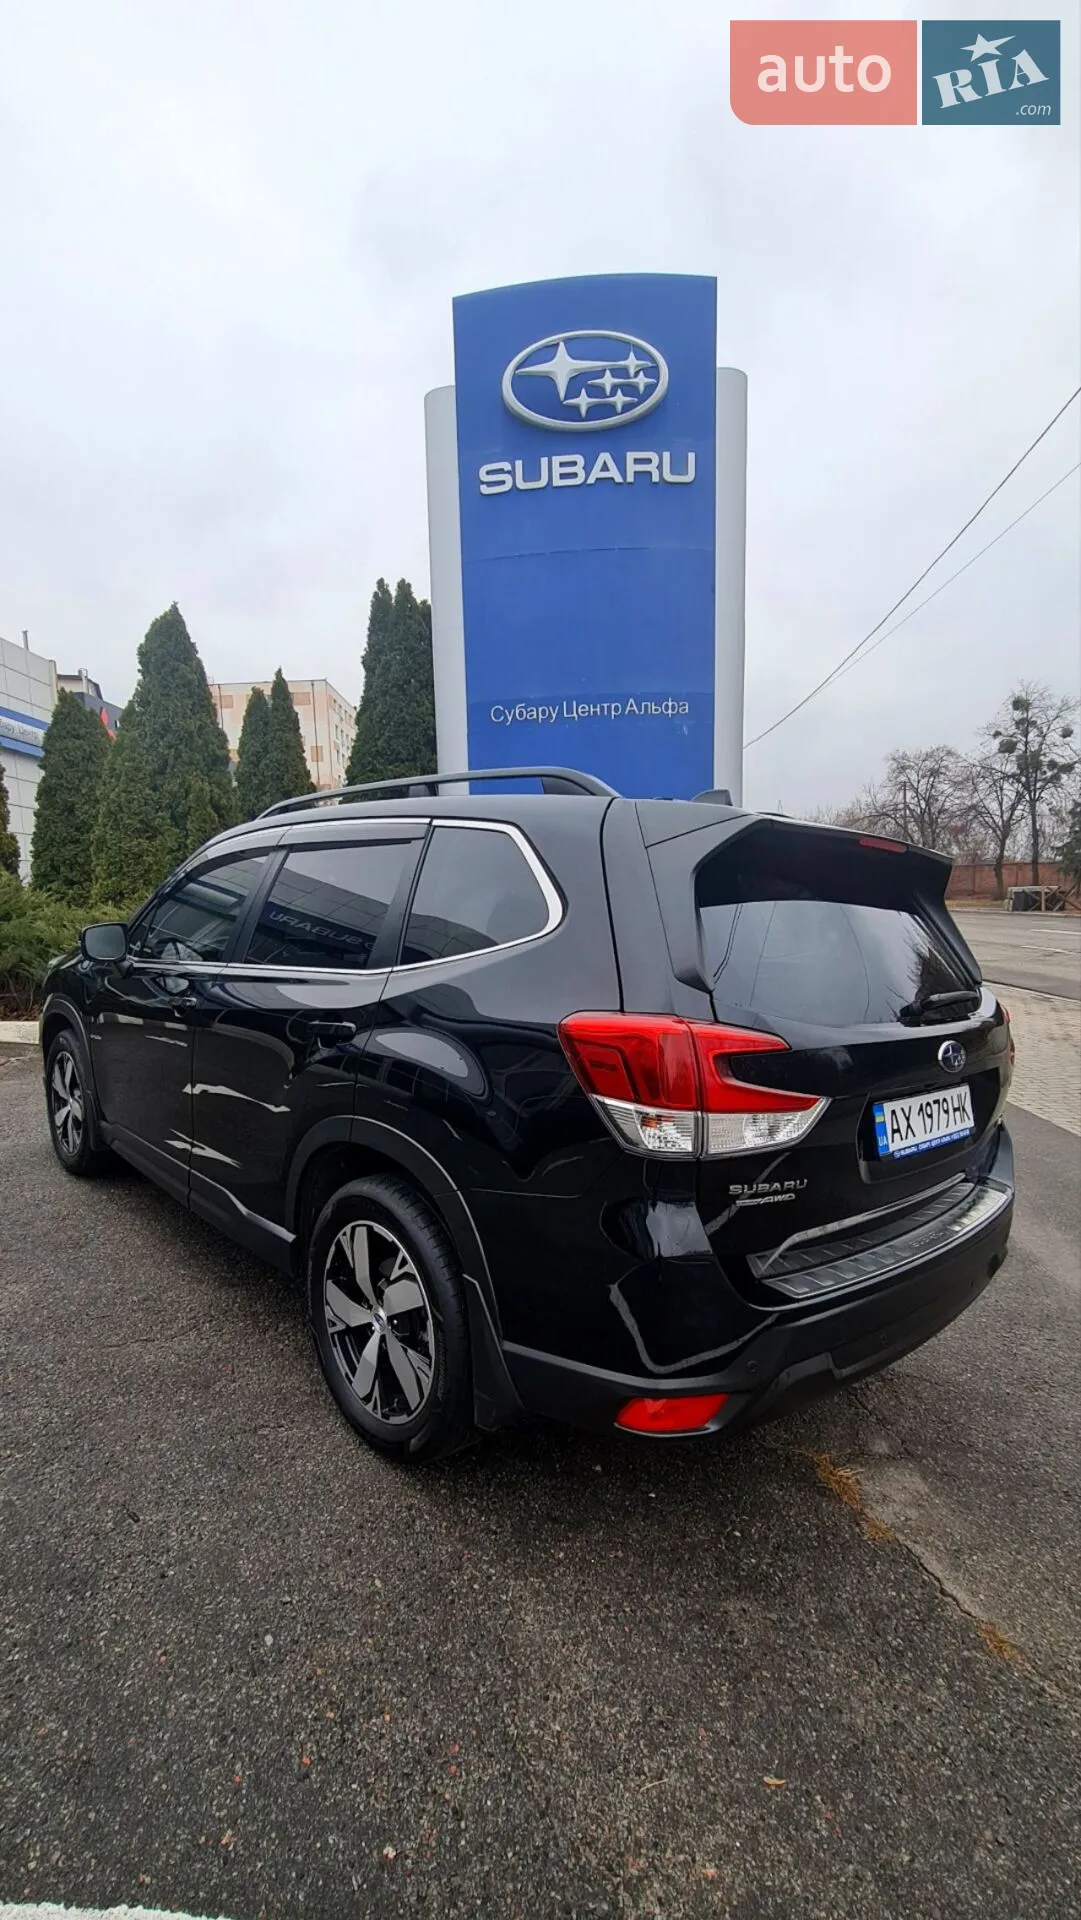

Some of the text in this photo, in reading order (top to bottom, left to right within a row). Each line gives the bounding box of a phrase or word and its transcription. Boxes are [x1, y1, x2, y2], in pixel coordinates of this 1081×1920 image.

[479, 451, 696, 495] SUBARU
[490, 697, 689, 726] Субару Центр Альфа
[891, 1109, 916, 1144] AX
[917, 1097, 949, 1135] 1979
[950, 1091, 971, 1126] HK
[728, 1178, 808, 1195] SUBARU
